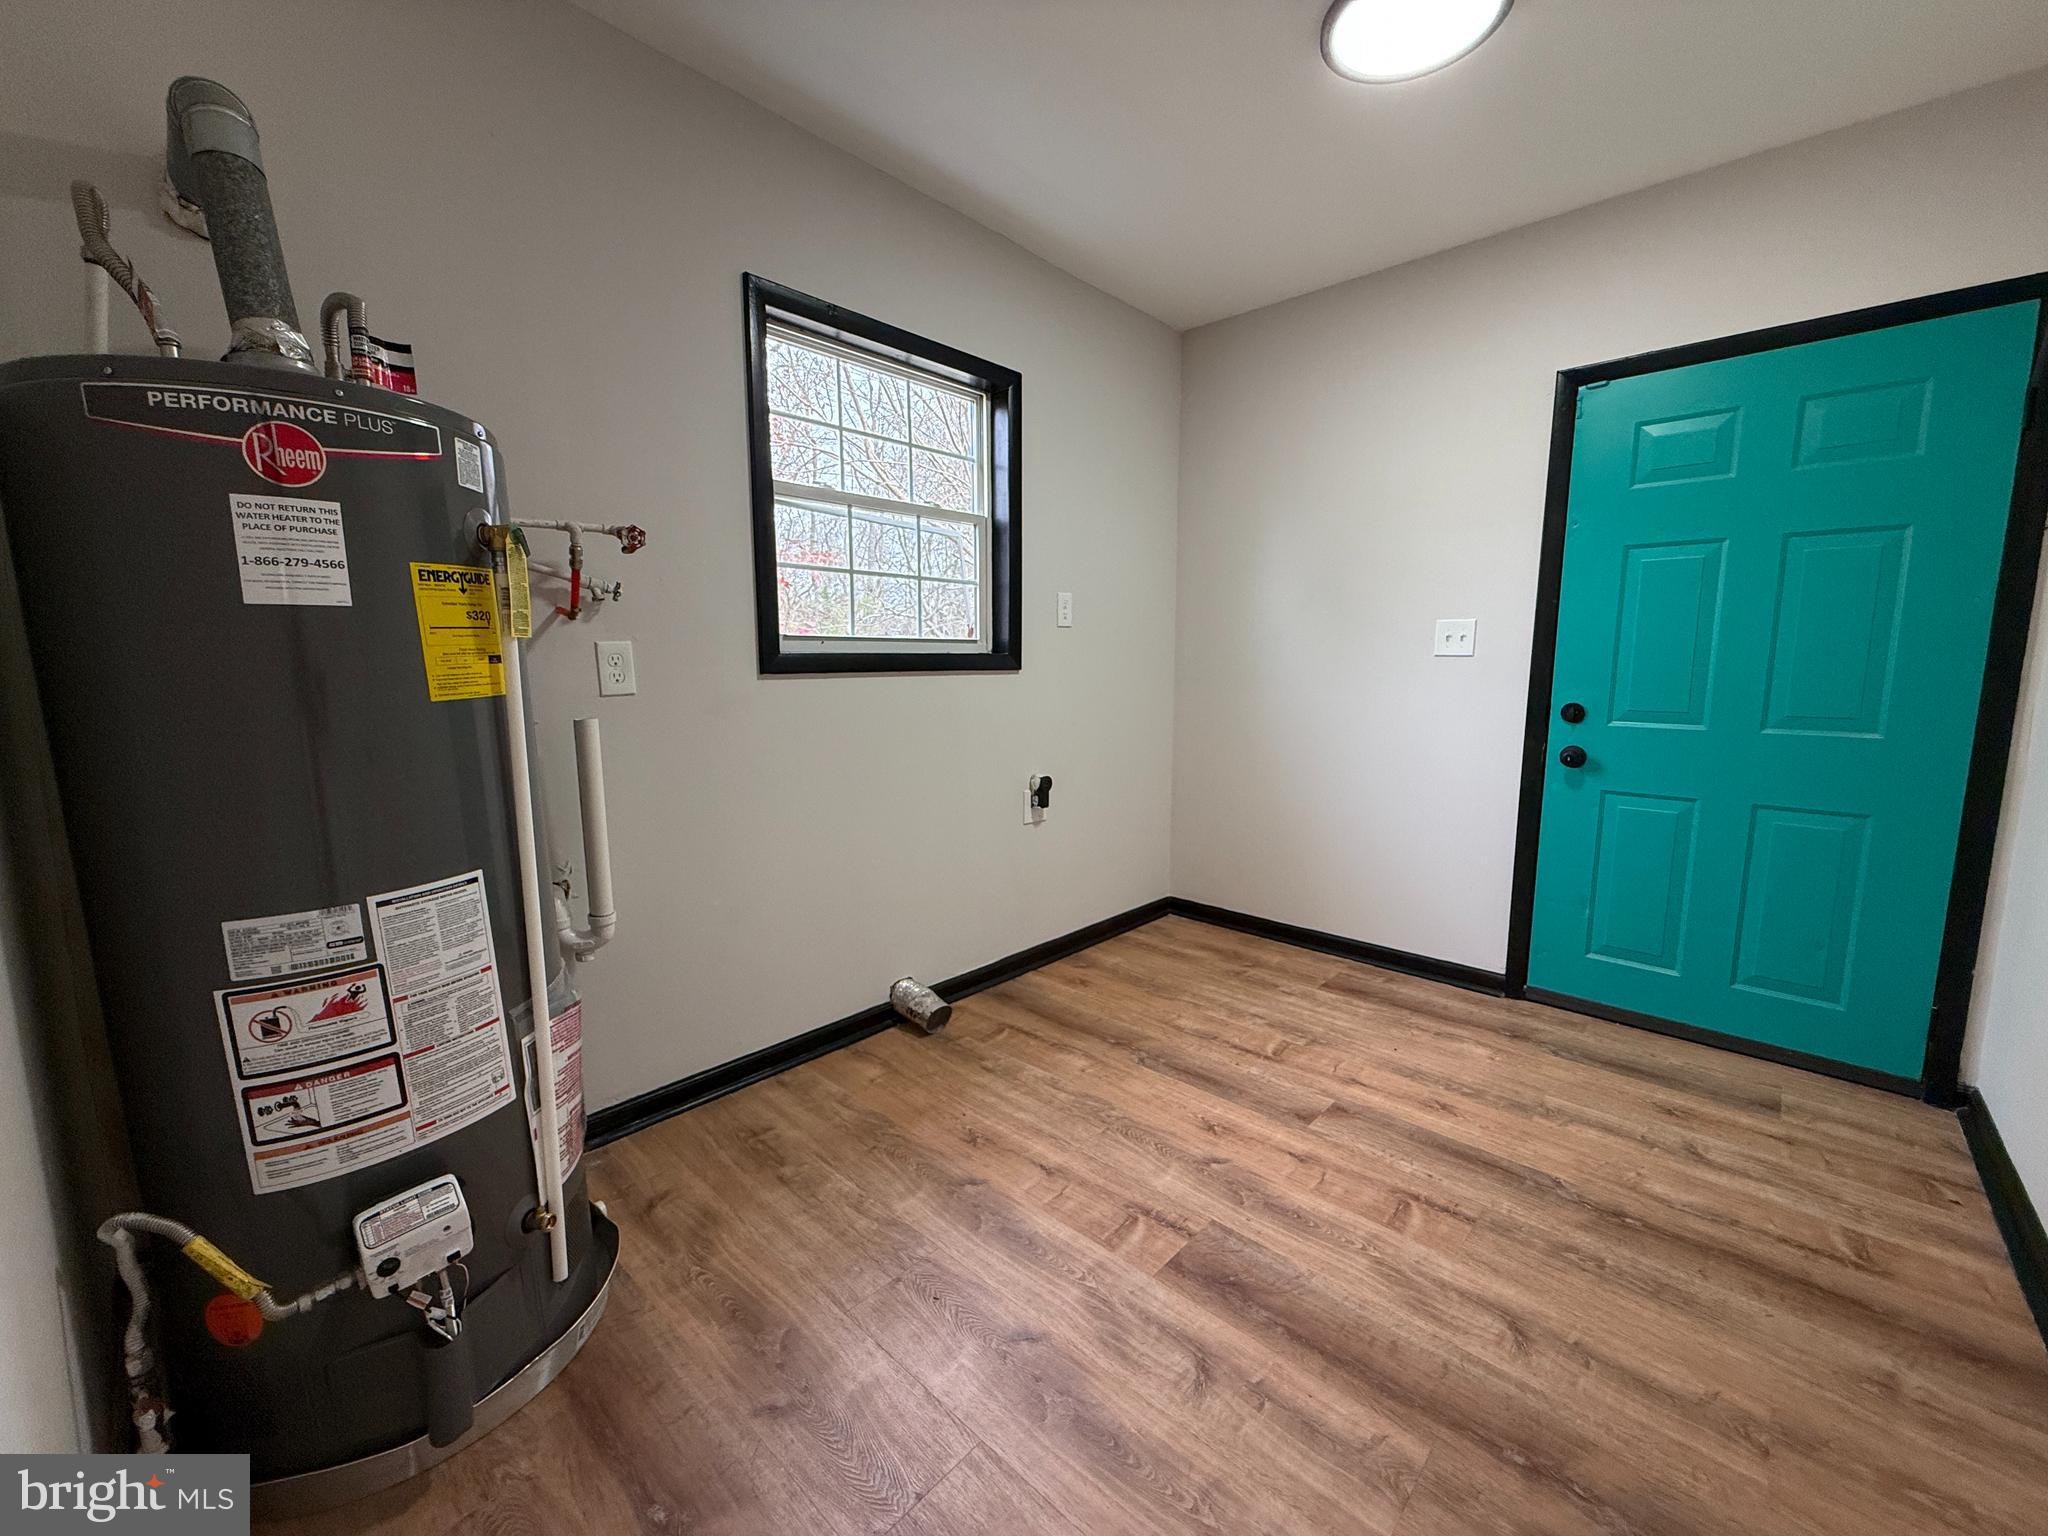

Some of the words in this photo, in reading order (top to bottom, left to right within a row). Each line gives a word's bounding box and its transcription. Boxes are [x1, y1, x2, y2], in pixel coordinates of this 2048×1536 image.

[147, 391, 338, 425] PERFORMANCE
[343, 413, 394, 435] PLUS
[252, 423, 322, 476] Rheem
[236, 501, 252, 509] DO
[254, 502, 276, 511] NOT
[278, 504, 316, 514] RETURN
[318, 507, 338, 516] THIS
[235, 511, 270, 520] WATER
[272, 514, 308, 524] HEATER
[309, 516, 322, 524] TO
[323, 517, 340, 526] THE
[242, 522, 271, 531] PLACE
[274, 524, 287, 532] OF
[289, 525, 338, 536] PURCHASE
[241, 555, 346, 570] 1-866-279-4566
[305, 1071, 351, 1088] DANGER
